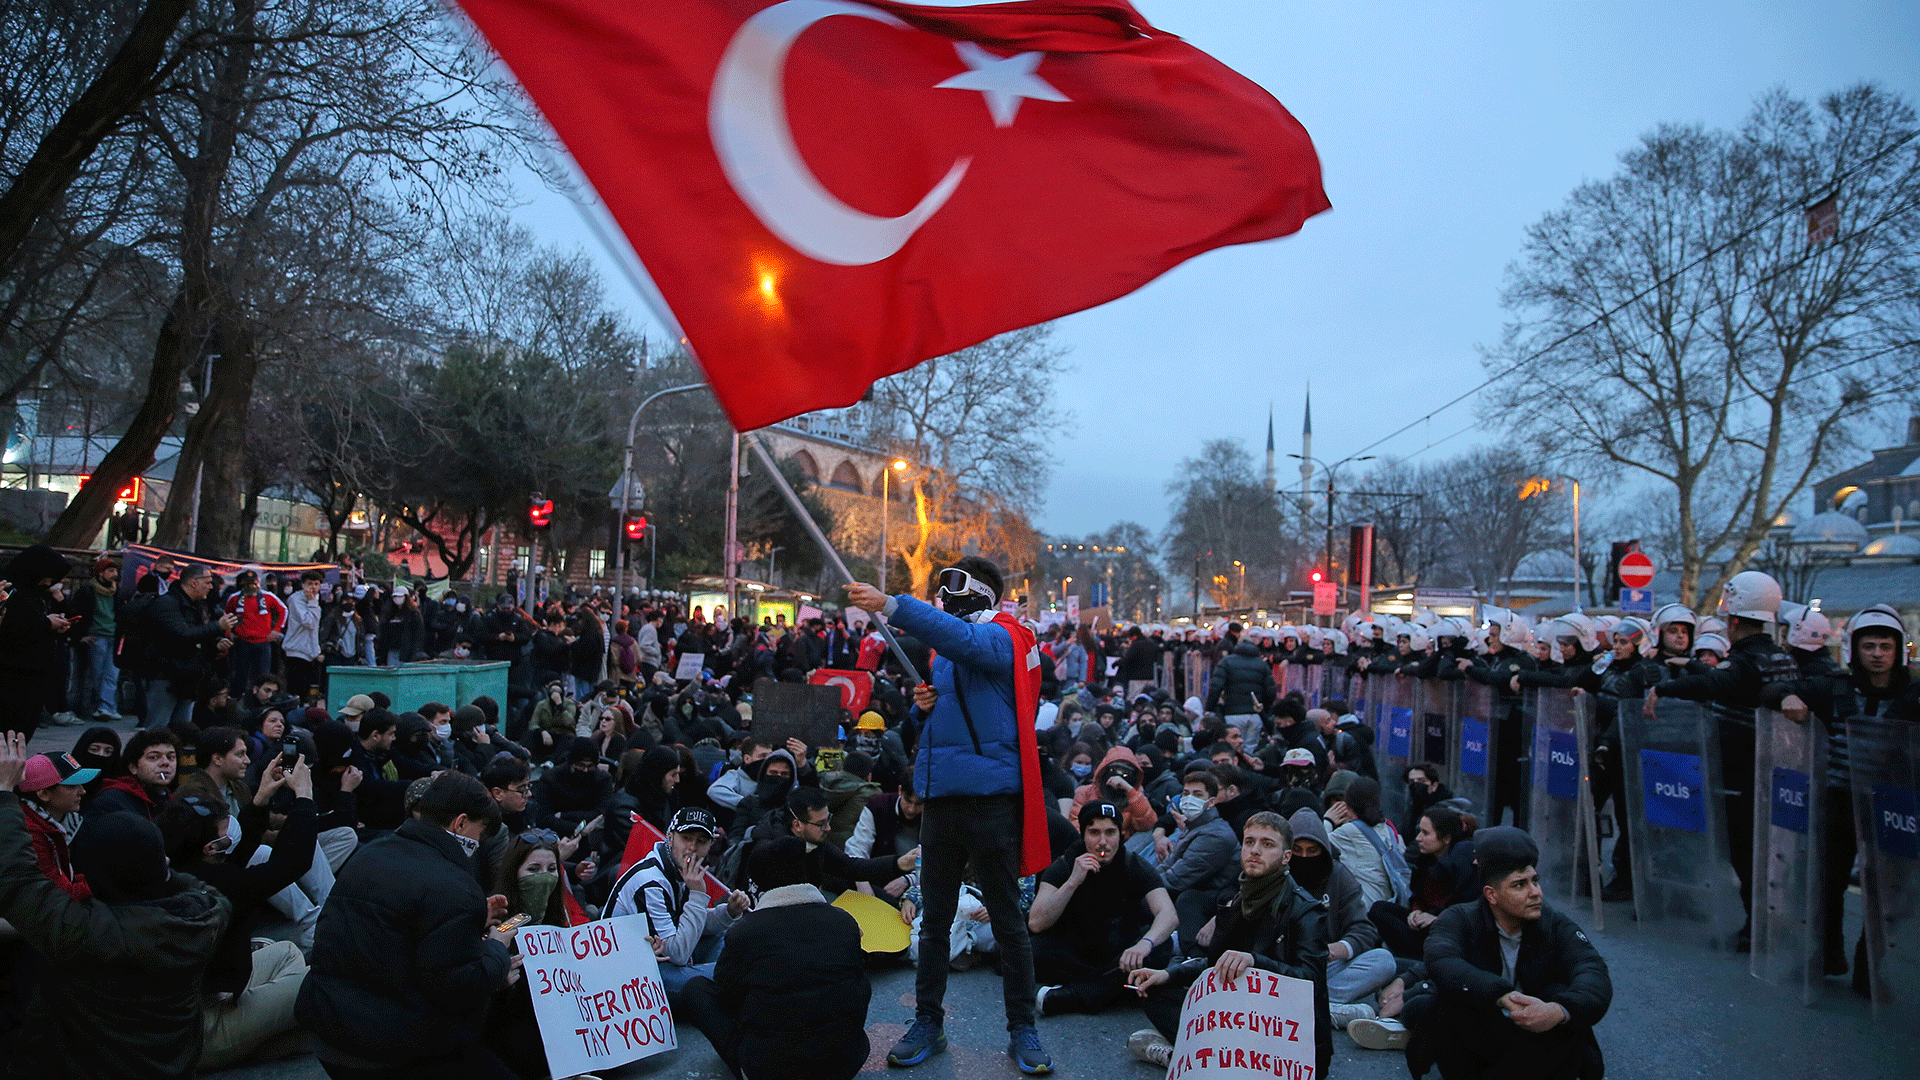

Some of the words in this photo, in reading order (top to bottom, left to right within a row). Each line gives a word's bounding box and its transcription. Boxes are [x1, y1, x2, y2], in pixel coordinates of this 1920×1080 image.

[1655, 782, 1690, 799] POLİS
[1883, 810, 1917, 833] POLİS
[524, 930, 567, 956] BİZİM
[571, 922, 619, 960] GİBİ
[537, 968, 552, 995] 3
[574, 990, 623, 1022] İSTER
[621, 976, 666, 1013] MİSİN
[1186, 1010, 1299, 1042] TÜRKÇÜYÜZ
